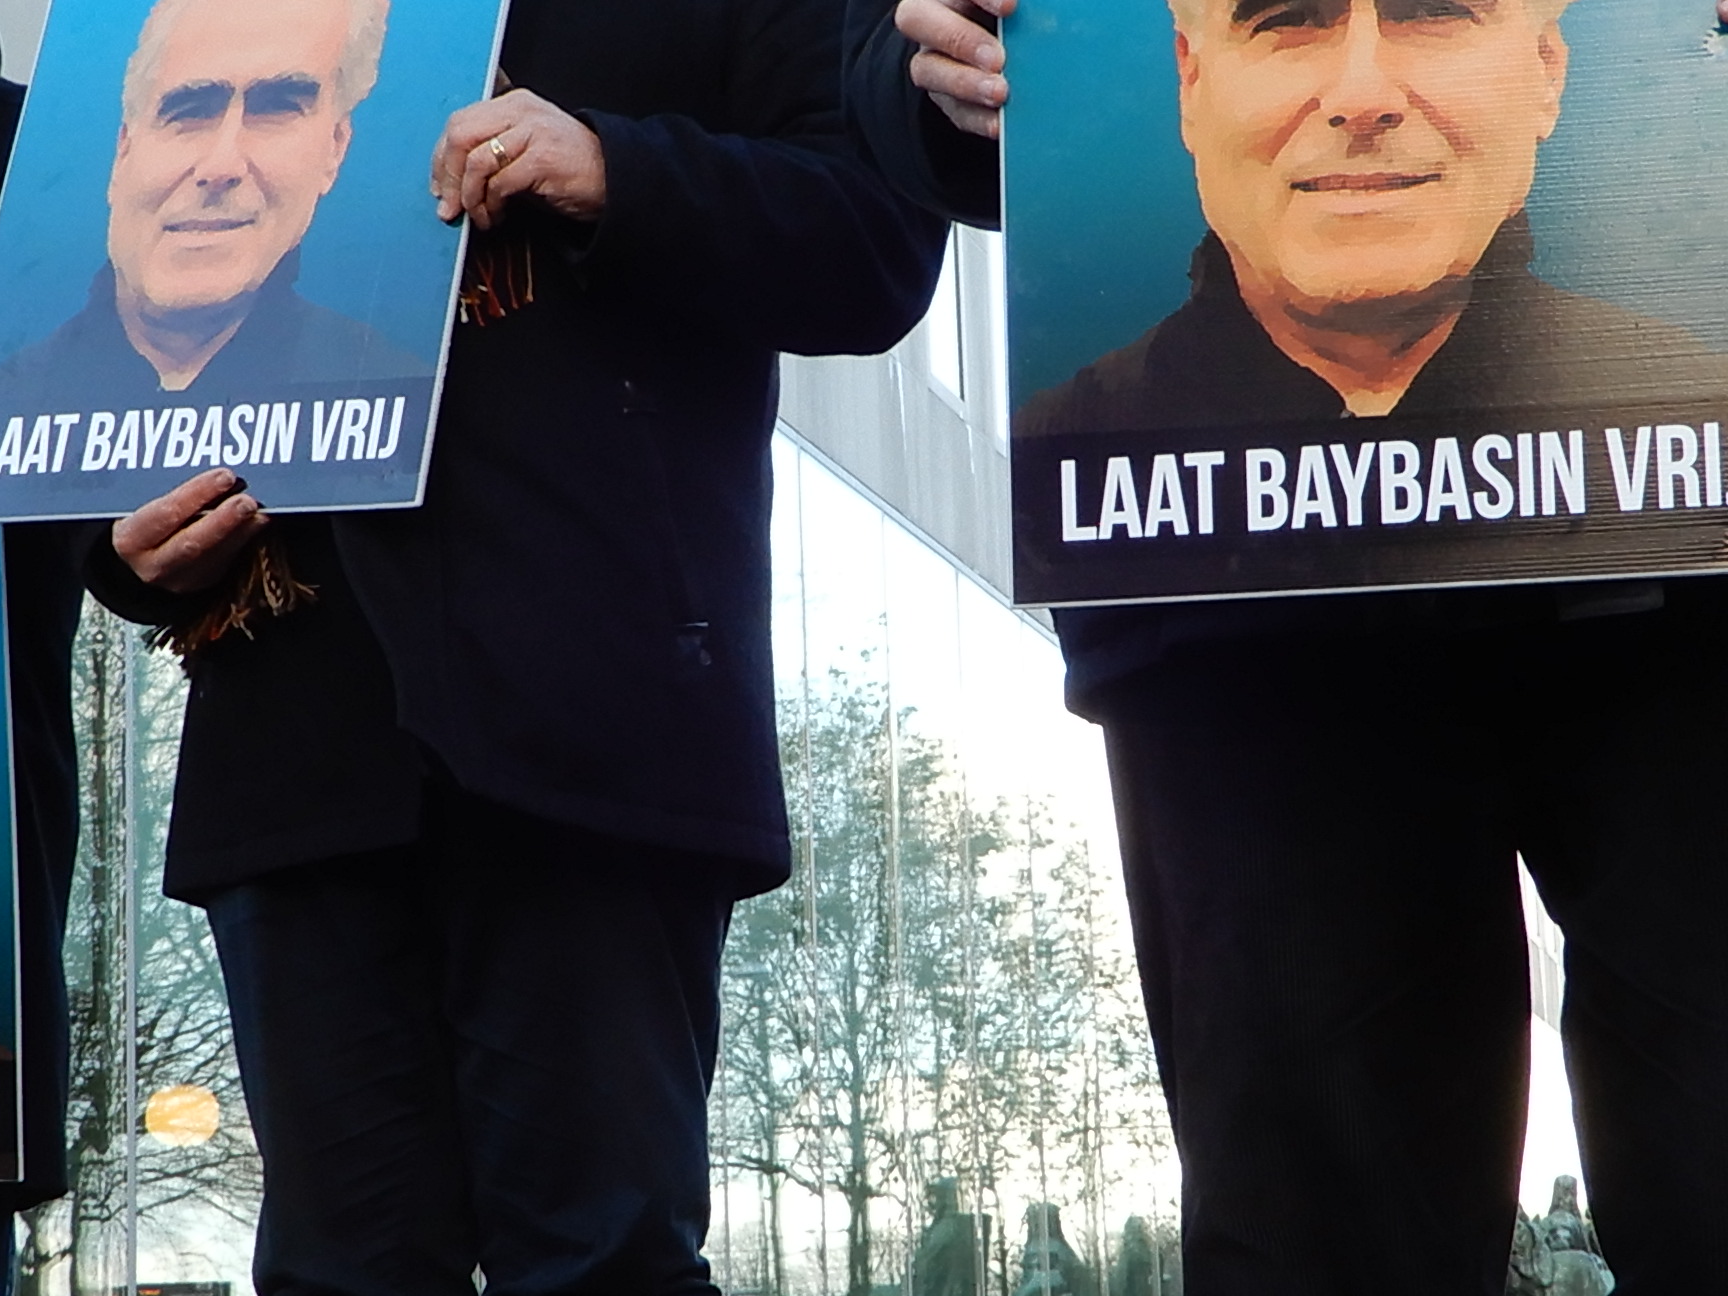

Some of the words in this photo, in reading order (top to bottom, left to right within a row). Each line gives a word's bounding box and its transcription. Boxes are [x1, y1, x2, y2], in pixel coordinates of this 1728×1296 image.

[84, 401, 300, 471] BAYBASIN
[309, 396, 406, 462] VRIJ
[1060, 450, 1225, 542] LAAT
[1245, 430, 1587, 533] BAYBASIN
